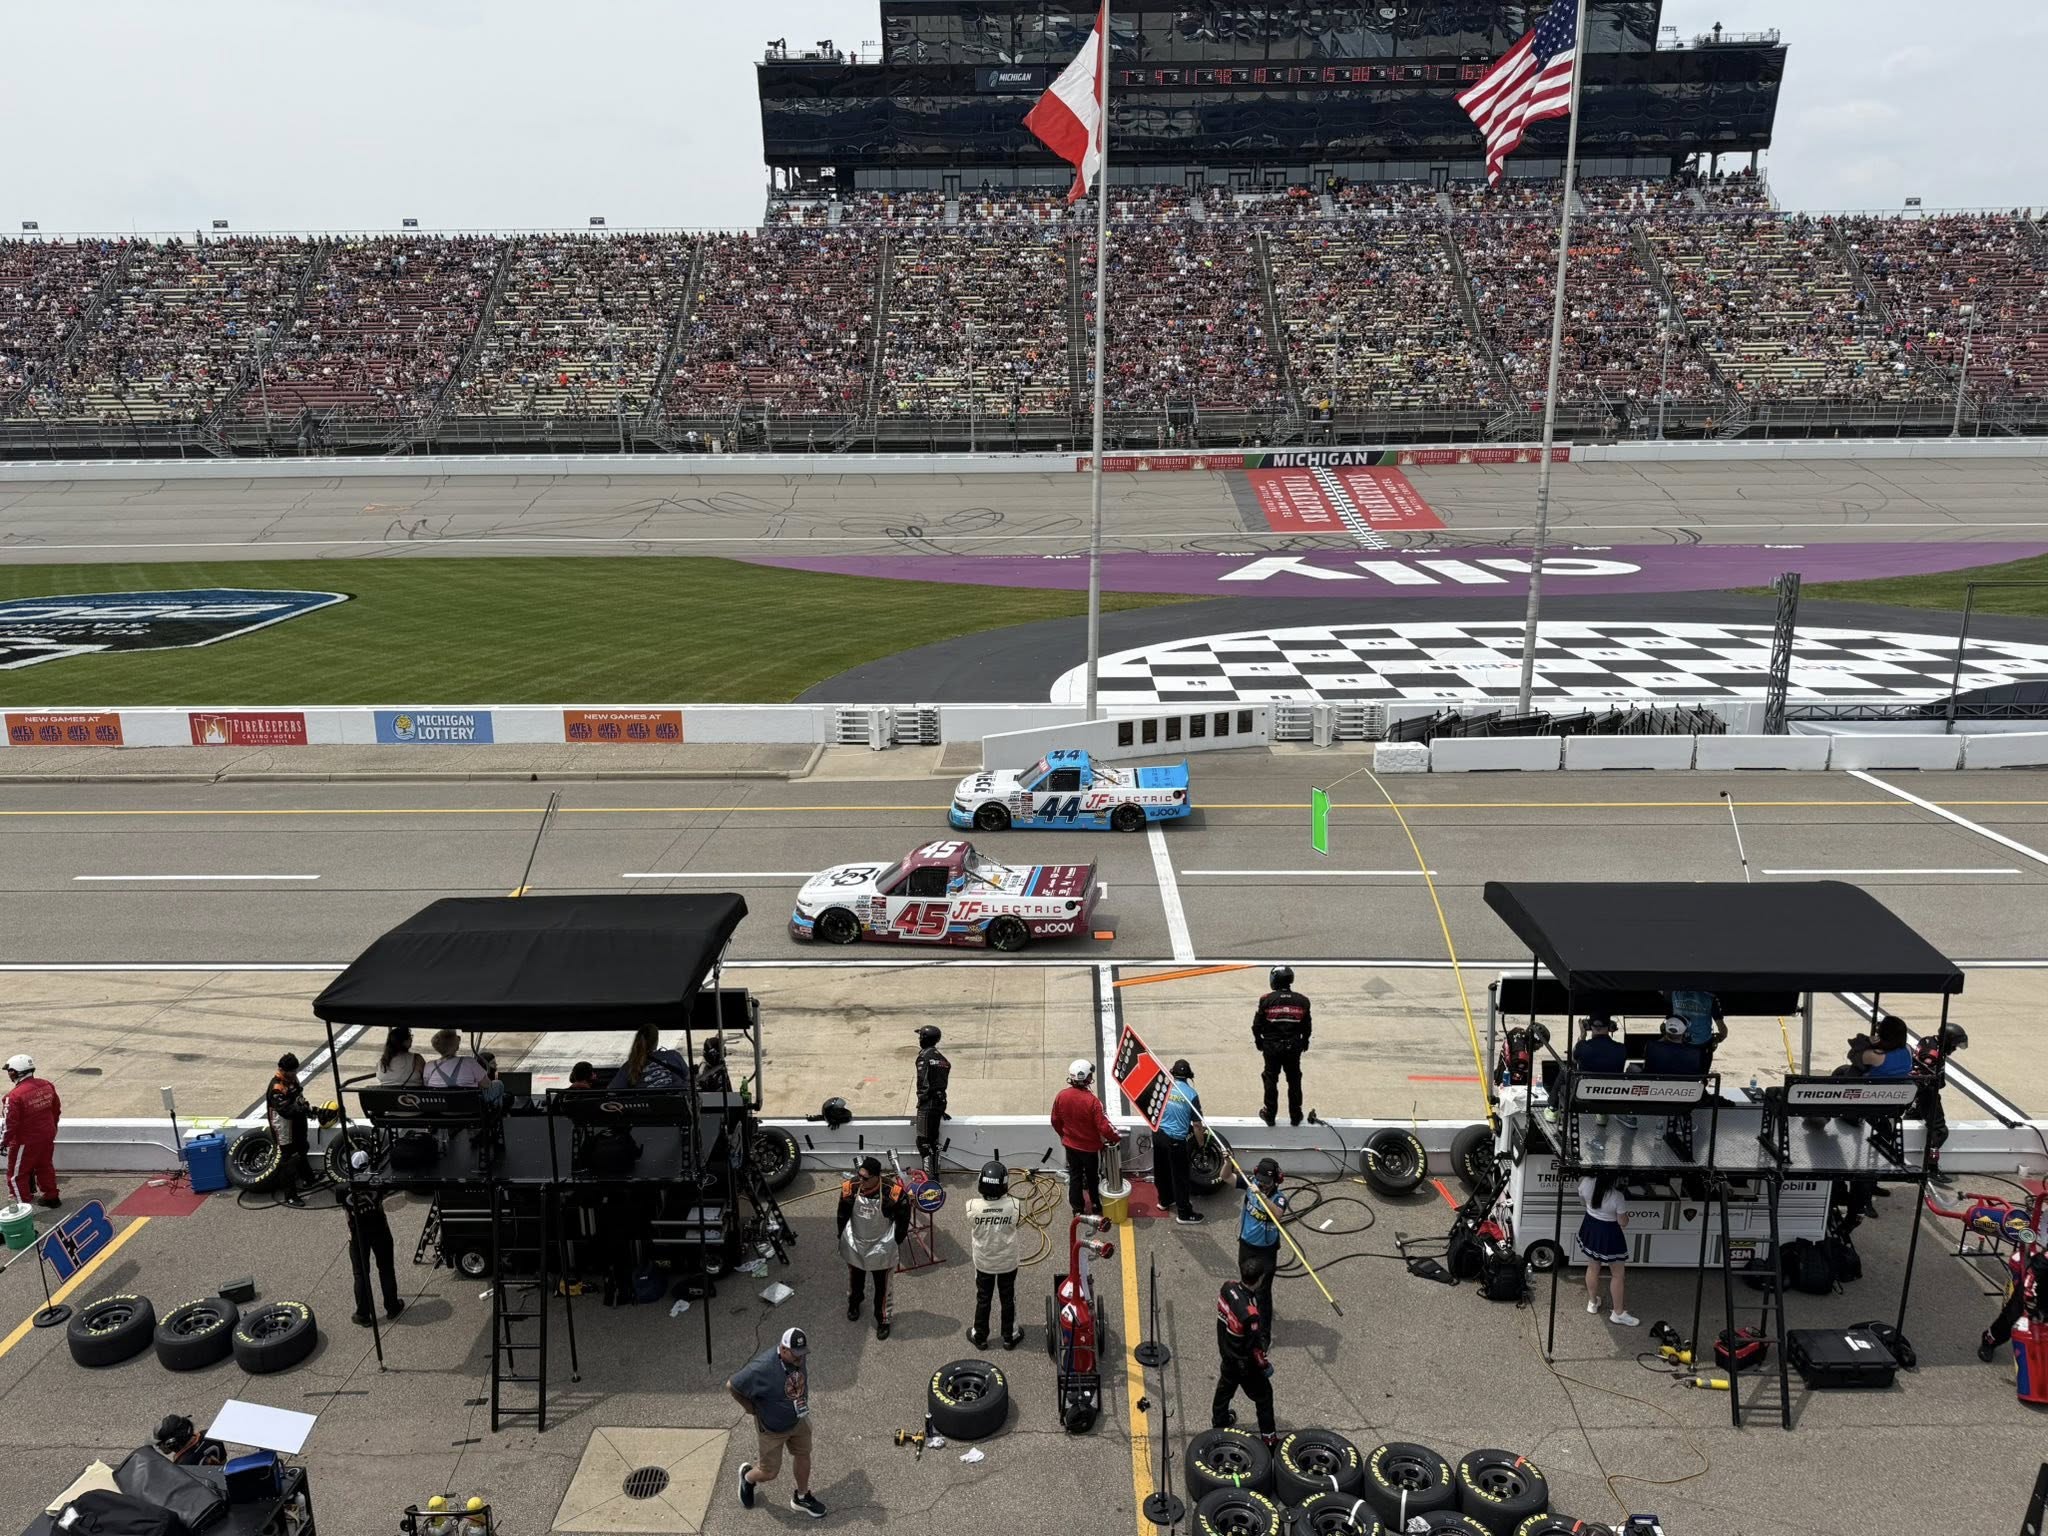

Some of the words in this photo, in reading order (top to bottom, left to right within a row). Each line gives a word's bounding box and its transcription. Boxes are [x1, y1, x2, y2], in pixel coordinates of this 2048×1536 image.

[998, 72, 1032, 81] MICHIGAN
[1273, 451, 1368, 467] MICHIGAN
[1218, 556, 1642, 585] ally
[416, 715, 475, 726] MICHIGAN
[417, 727, 475, 740] LOTTERY
[1051, 749, 1082, 761] 44
[1109, 795, 1173, 803] ELECTRIC
[1036, 795, 1083, 824] 44
[920, 840, 964, 859] 45
[982, 904, 1062, 913] ELECTRIC
[888, 901, 952, 940] 45
[1034, 923, 1075, 934] eJOOV
[1585, 1086, 1631, 1095] TRICON
[1649, 1087, 1696, 1097] GARAGE
[1796, 1090, 1842, 1099] TRICON
[1862, 1090, 1909, 1099] GARAGE
[228, 1135, 244, 1156] EAGLE
[785, 1138, 796, 1159] EAGLE
[1407, 1135, 1425, 1178] GOODYEAR
[1537, 1174, 1580, 1183] TRION
[974, 1215, 1012, 1226] OFFICIAL
[39, 1200, 116, 1284] 13
[1730, 1249, 1752, 1259] SEM
[932, 1371, 956, 1406] GOODYEAR
[1223, 1427, 1252, 1438] EAGLE
[1280, 1434, 1300, 1474] GOODYEAR
[1347, 1446, 1357, 1468] EAGLE
[1195, 1460, 1251, 1480] GODYEAR
[1370, 1446, 1388, 1487] GOODYEAR
[1439, 1463, 1450, 1486] EAGLE
[1461, 1463, 1502, 1503] GOODYEAR
[1302, 1492, 1326, 1508] EAGLE
[1249, 1491, 1280, 1536] GOODYEAR
[1519, 1513, 1549, 1536] DYEAR
